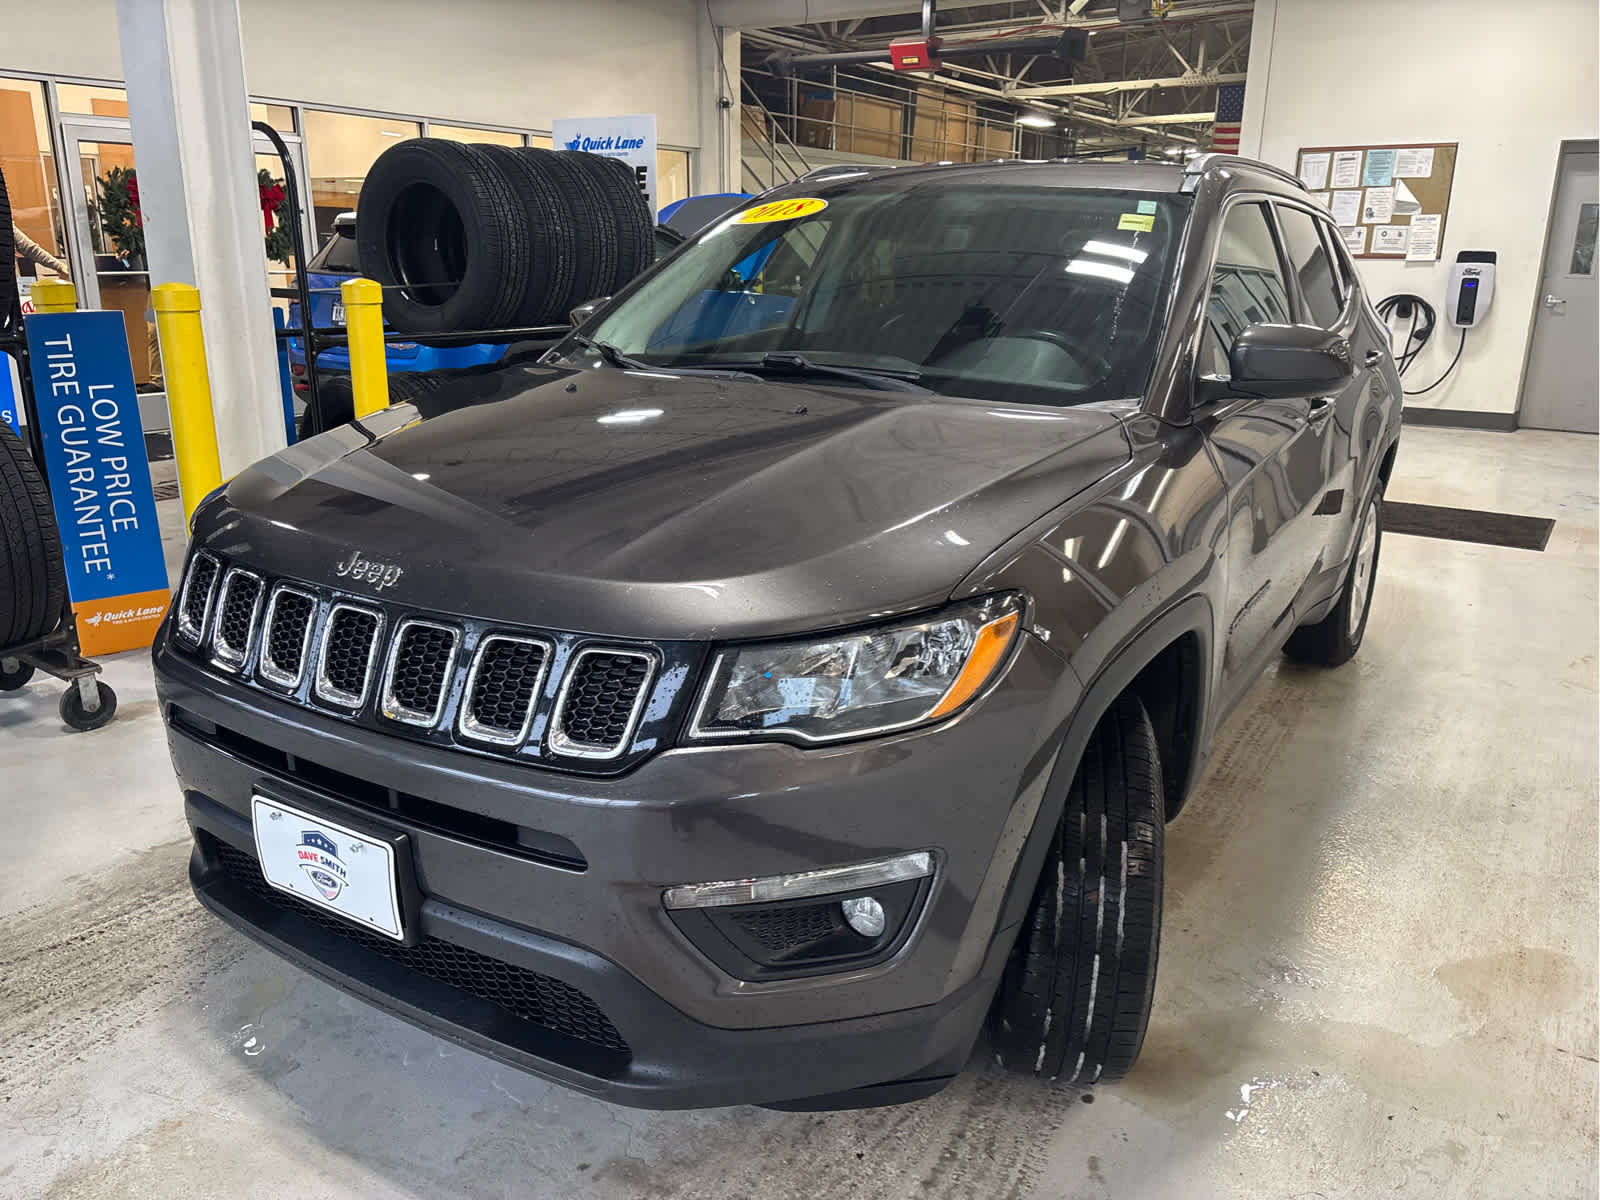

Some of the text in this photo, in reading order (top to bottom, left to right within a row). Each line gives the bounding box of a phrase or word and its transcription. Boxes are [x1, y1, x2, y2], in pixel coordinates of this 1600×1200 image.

[582, 135, 644, 152] Quick Lane
[44, 333, 80, 397] TIRE
[88, 384, 139, 533] LOW PRICE
[336, 551, 402, 591] Jeep
[103, 605, 164, 622] Quick Lane
[298, 850, 346, 878] DAVE SMITH
